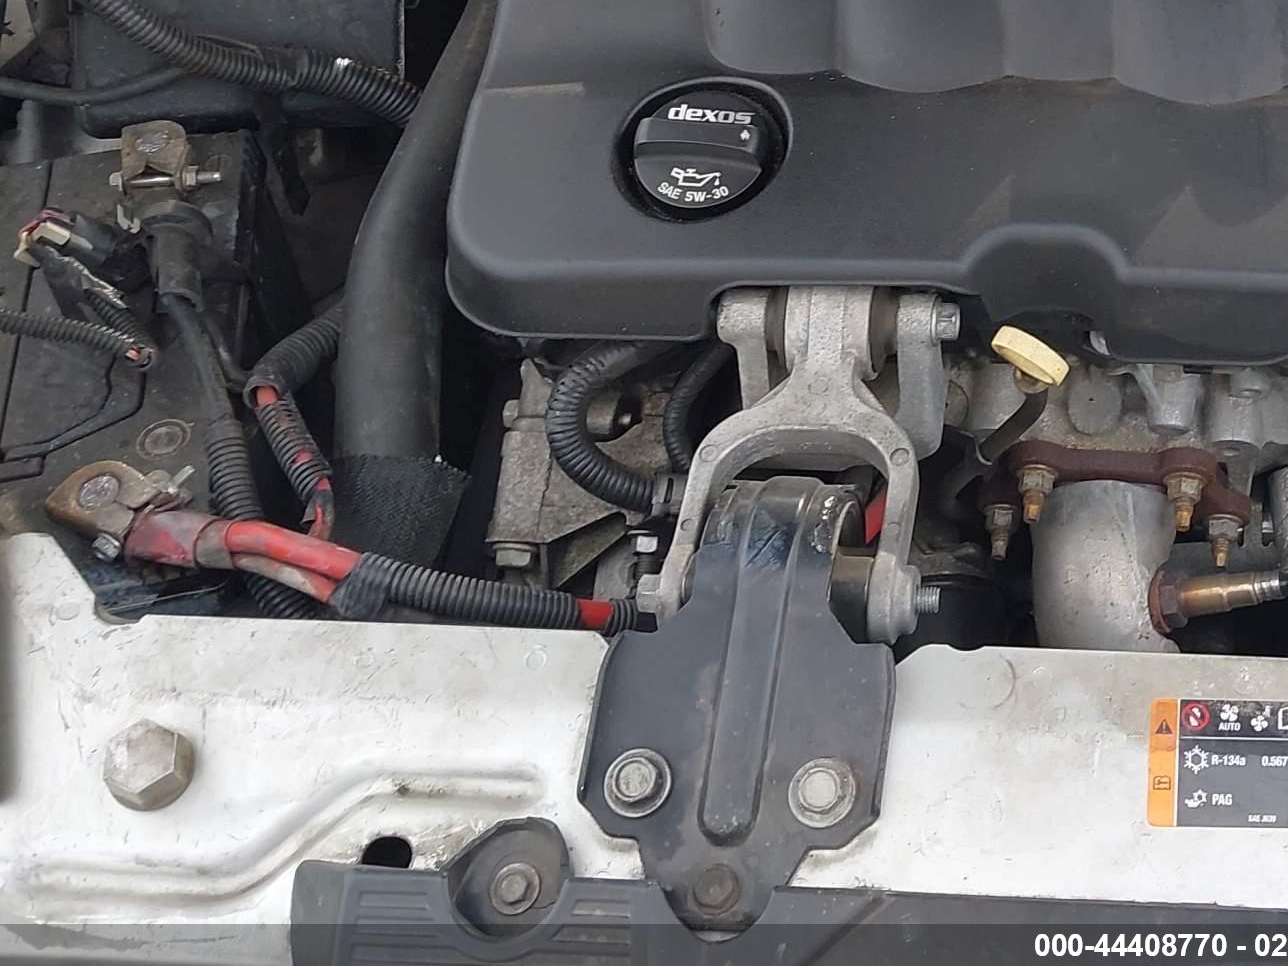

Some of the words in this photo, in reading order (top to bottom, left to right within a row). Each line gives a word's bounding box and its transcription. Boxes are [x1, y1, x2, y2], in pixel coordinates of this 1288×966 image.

[667, 103, 756, 125] dexos
[657, 181, 683, 200] SAE
[684, 185, 730, 203] 5W-30
[1218, 721, 1242, 732] AUTO
[1211, 754, 1247, 767] R-134a
[1261, 755, 1288, 767] 0.567
[1211, 793, 1233, 806] PAG
